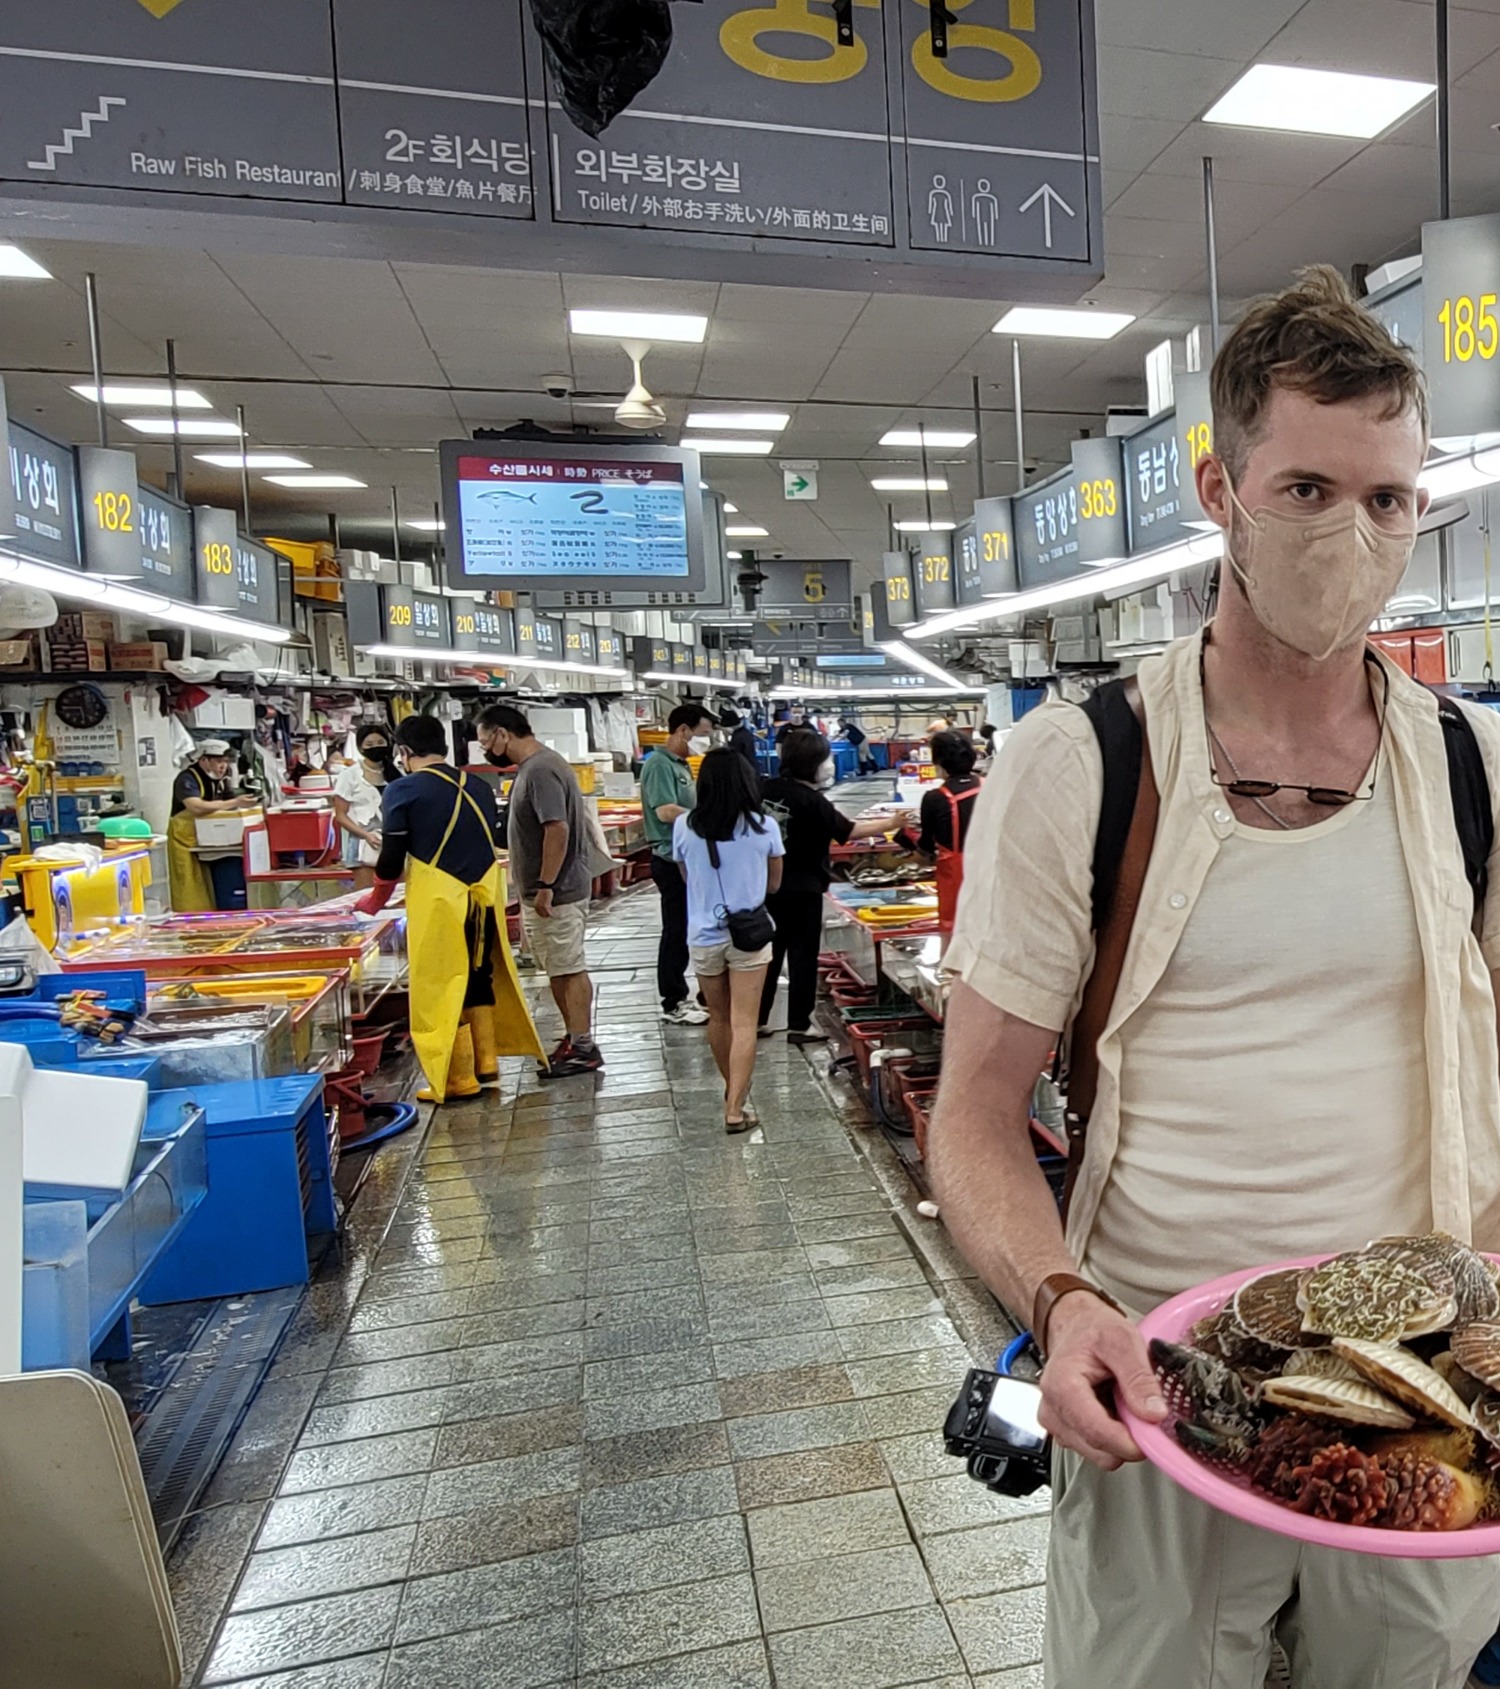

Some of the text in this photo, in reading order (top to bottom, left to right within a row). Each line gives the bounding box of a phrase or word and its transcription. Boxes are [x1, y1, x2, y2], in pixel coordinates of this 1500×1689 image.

[130, 152, 176, 175] Raw
[184, 156, 227, 179] Fish
[574, 149, 742, 193] 외부화장실
[1437, 292, 1500, 363] 185
[591, 468, 621, 480] PRICE
[94, 490, 133, 531] 182
[1081, 478, 1116, 519] 363
[203, 543, 232, 575] 183
[982, 530, 1009, 562] 371
[924, 556, 949, 583] 372
[887, 577, 911, 601] 373
[389, 605, 411, 626] 209
[456, 615, 474, 634] 210
[519, 624, 534, 641] 211
